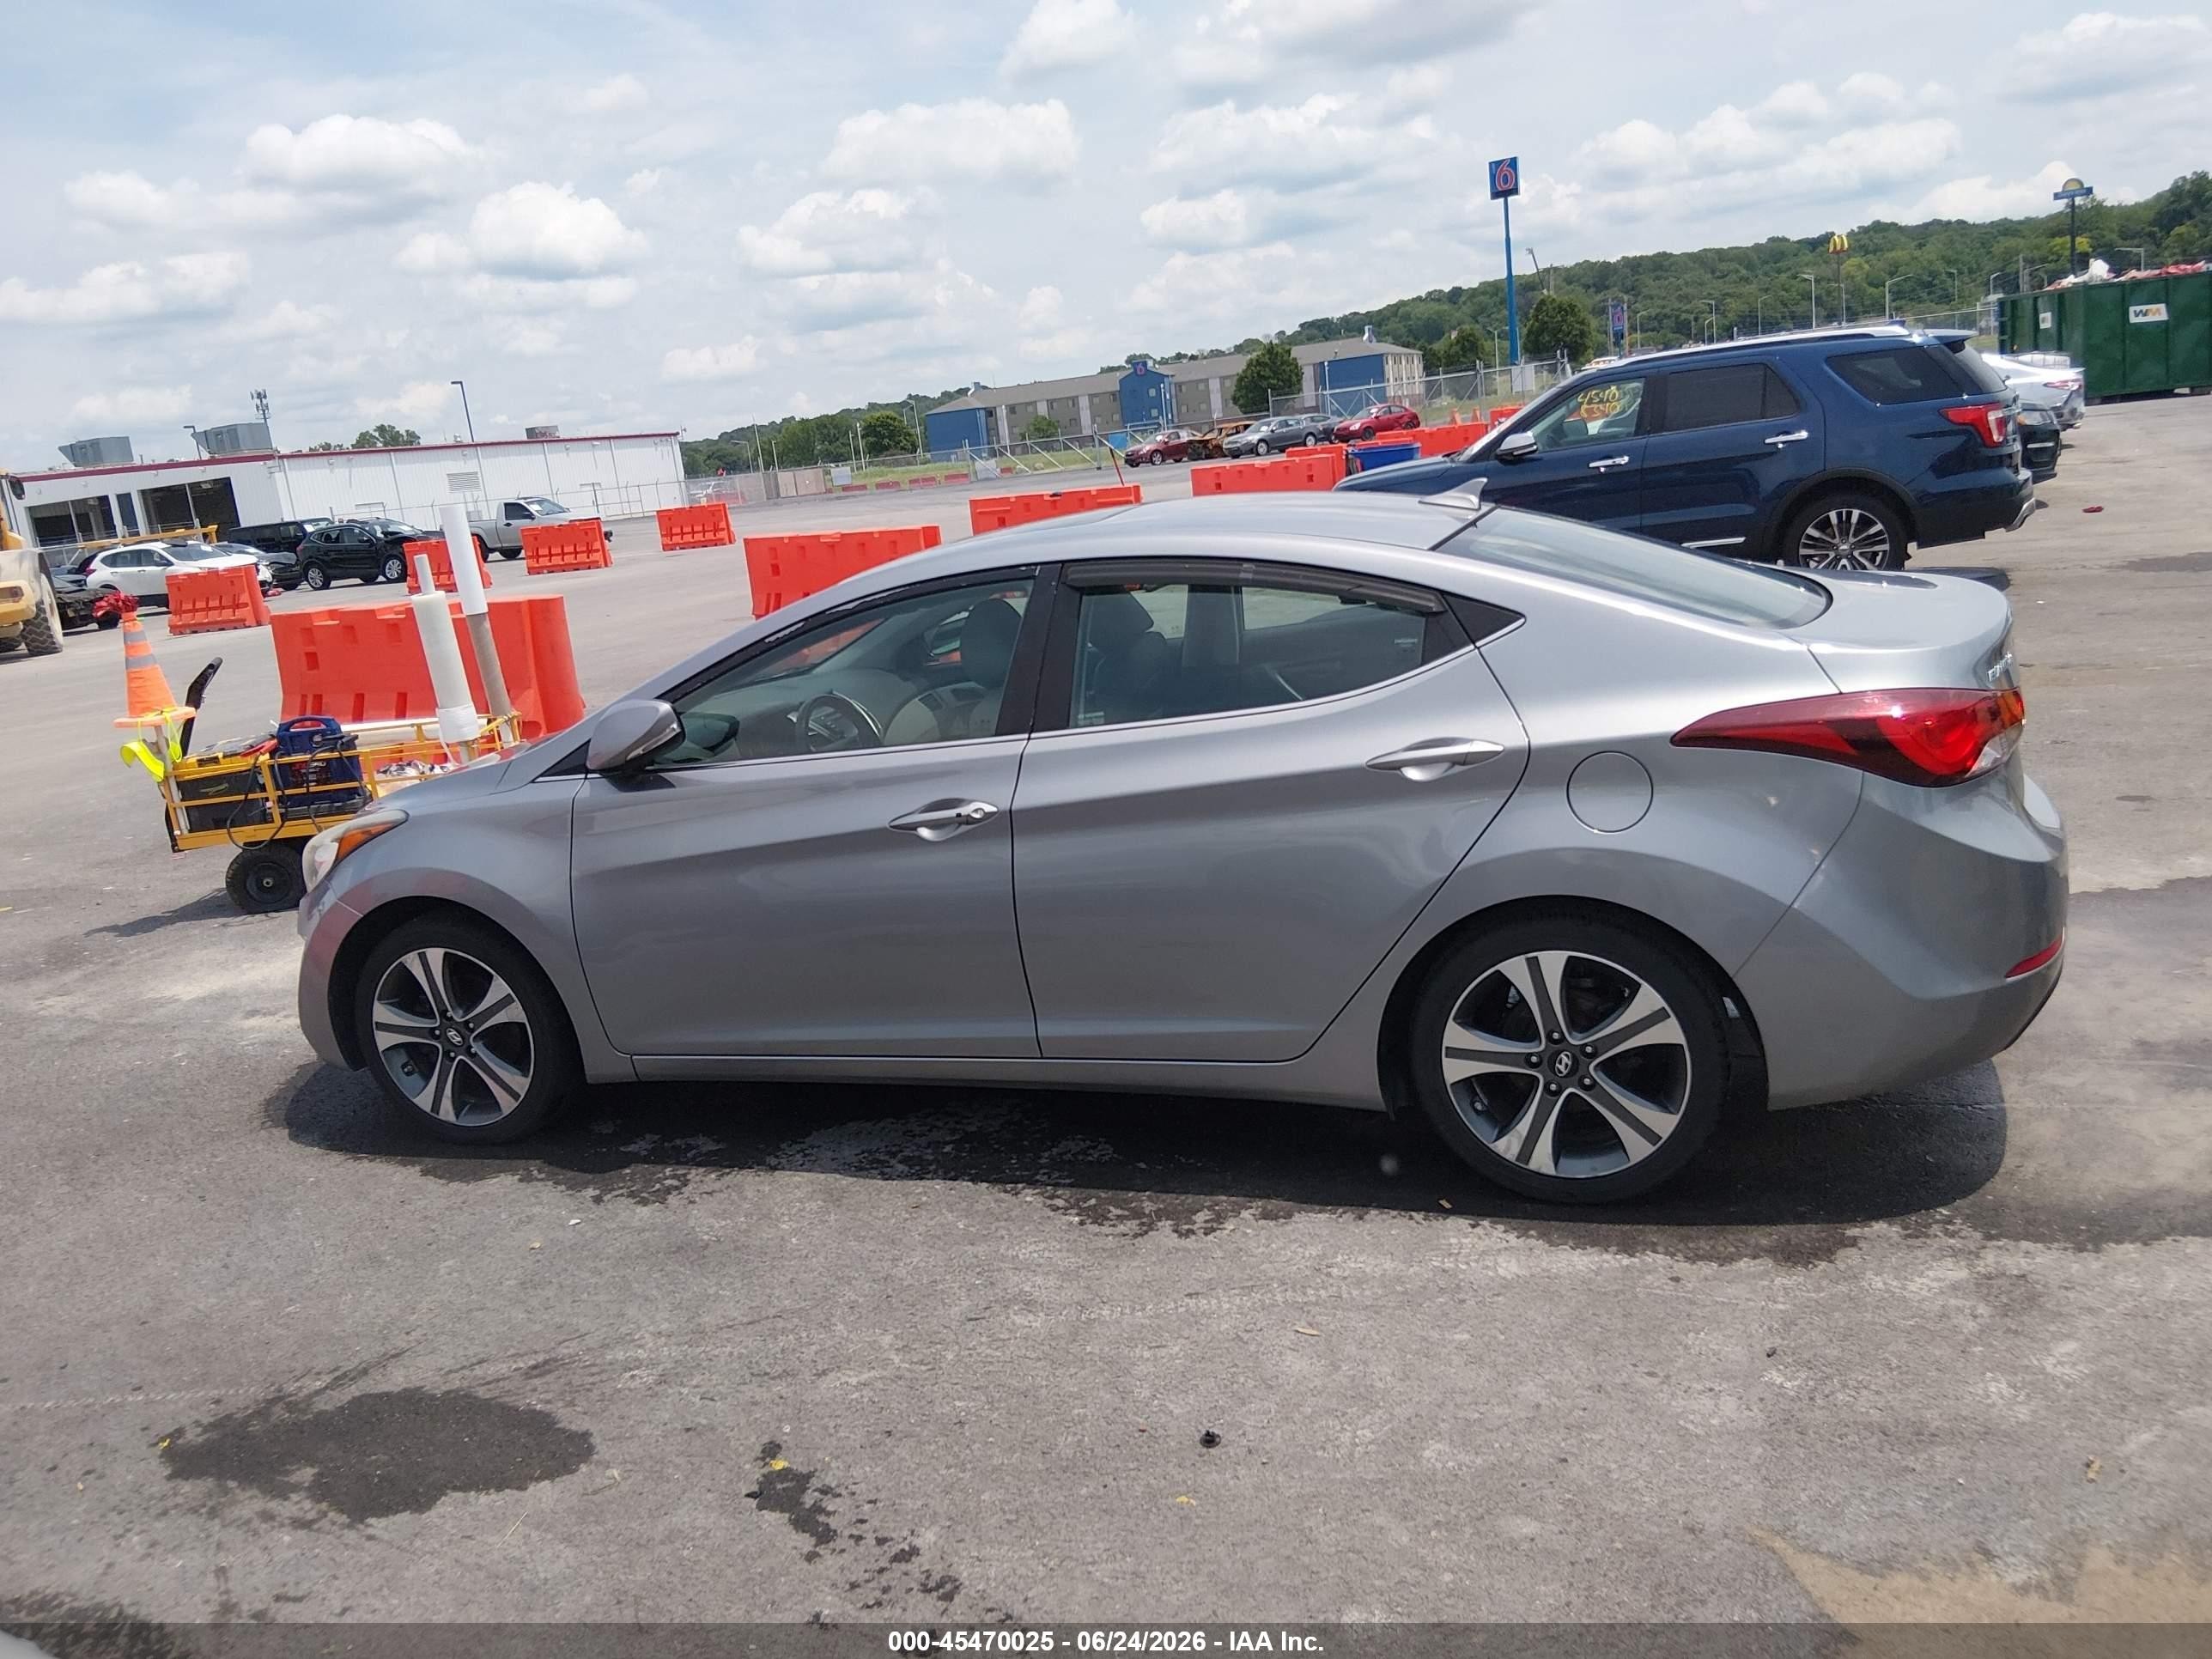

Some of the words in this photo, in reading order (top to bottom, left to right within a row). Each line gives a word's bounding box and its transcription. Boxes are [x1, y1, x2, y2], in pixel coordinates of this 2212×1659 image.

[1495, 159, 1515, 191] 6
[2133, 307, 2161, 318] WM
[1136, 362, 1145, 375] 6
